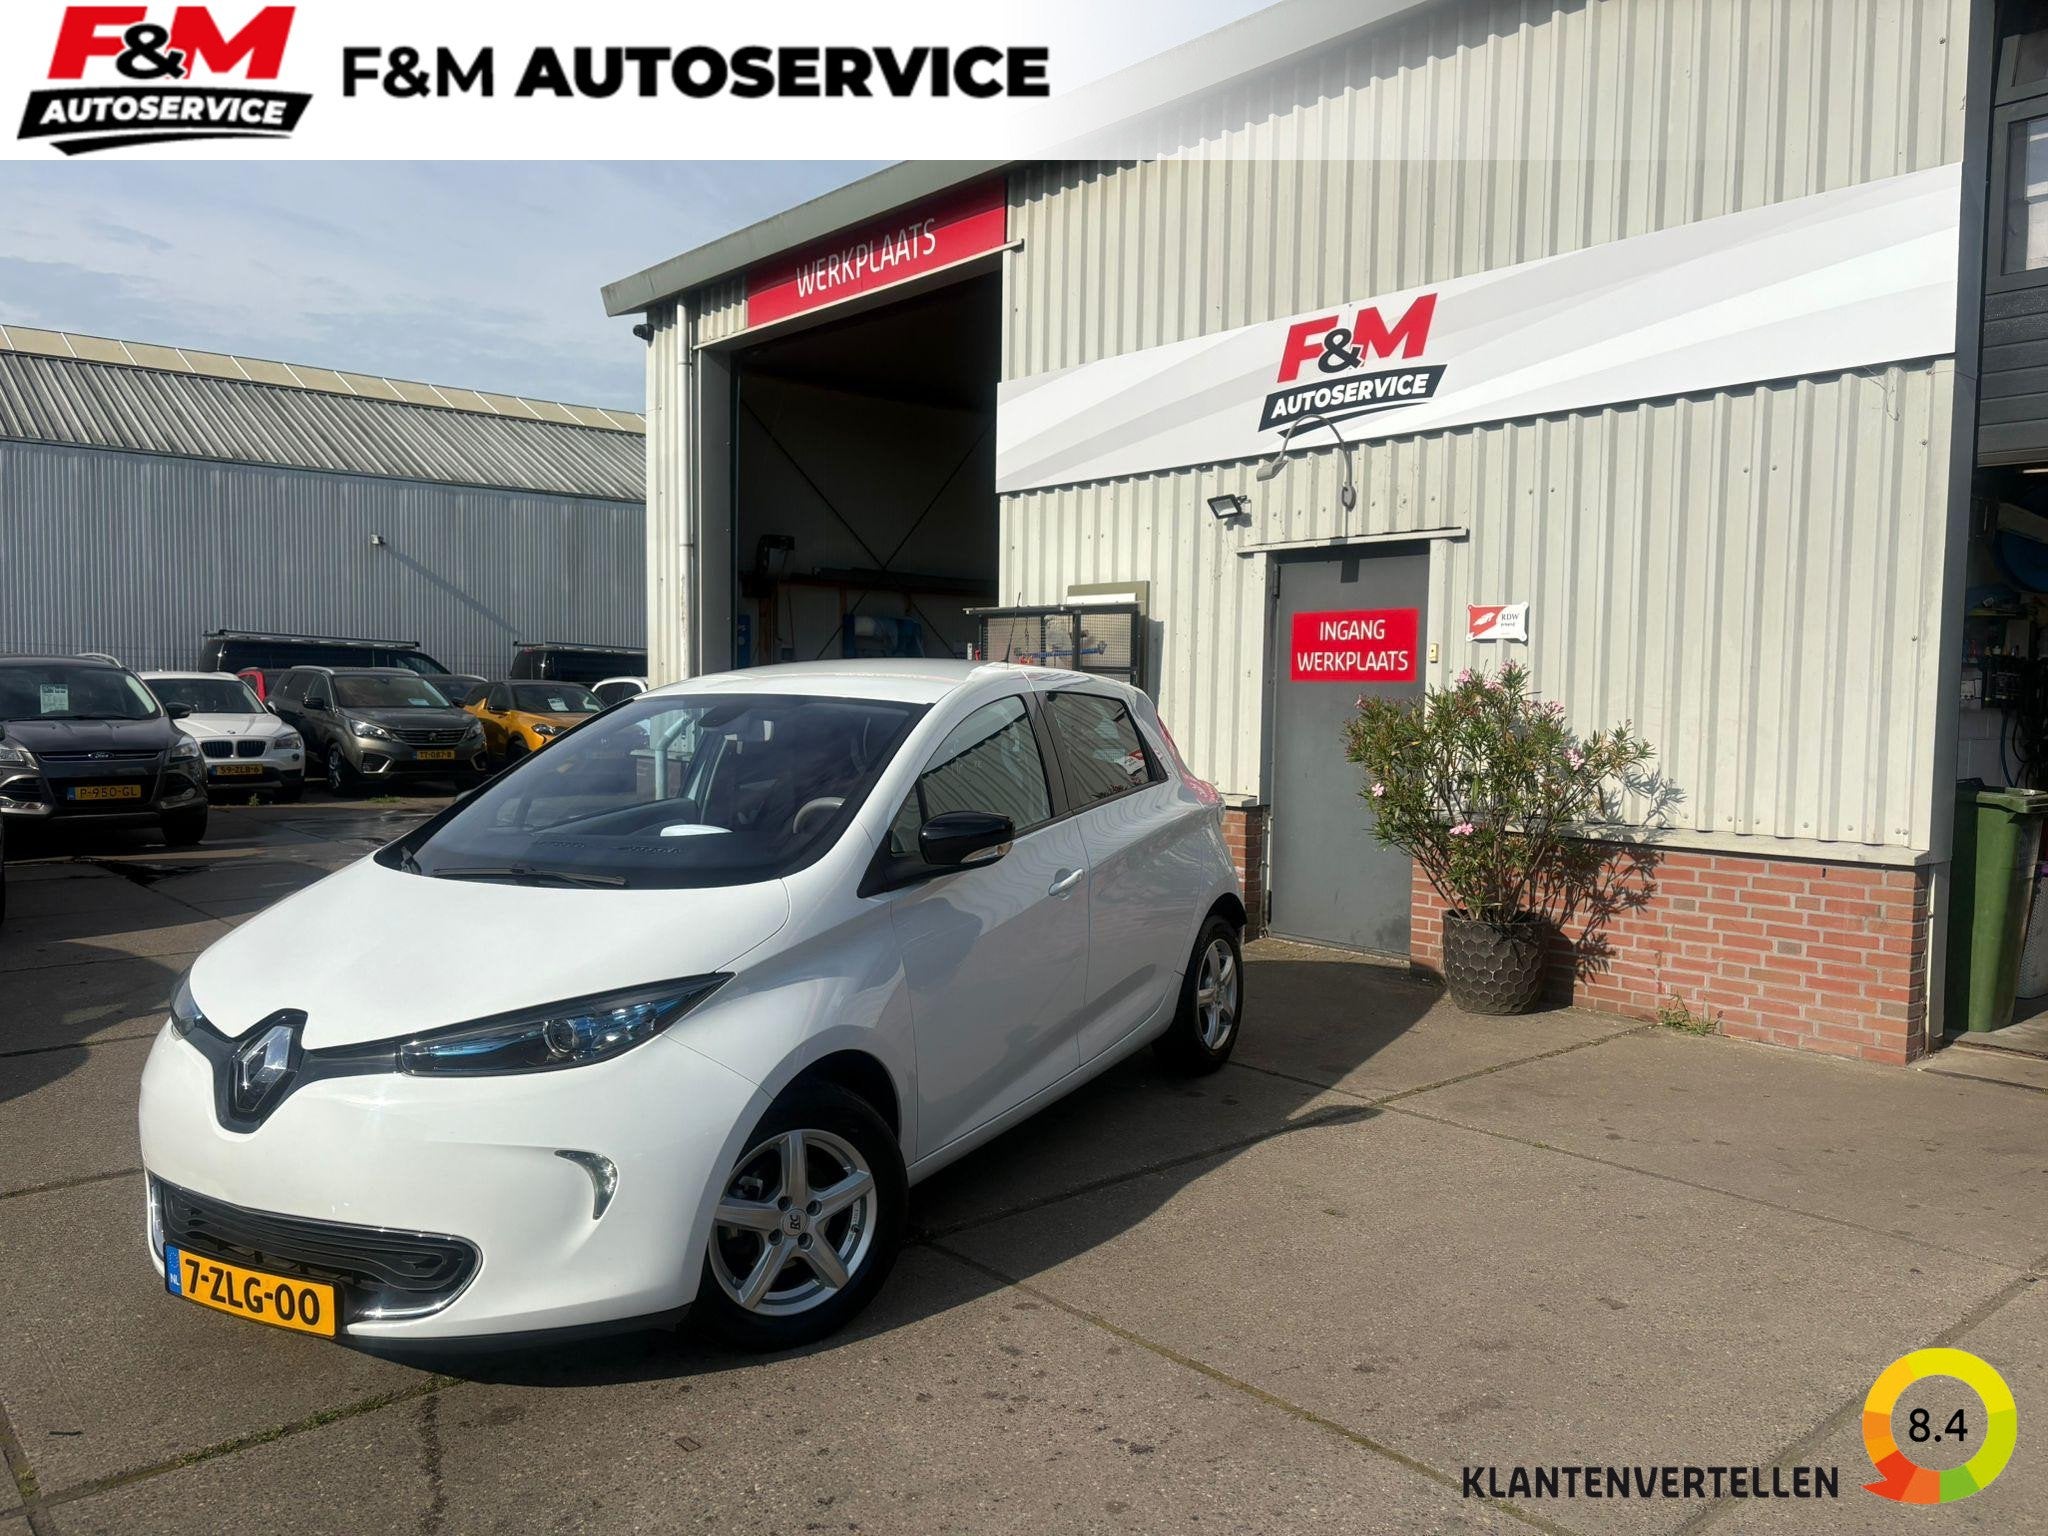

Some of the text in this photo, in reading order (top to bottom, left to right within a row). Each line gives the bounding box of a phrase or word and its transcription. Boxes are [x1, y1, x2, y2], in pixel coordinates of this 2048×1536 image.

[796, 217, 936, 298] WERKPLAATS
[1276, 292, 1438, 383] F&M
[1270, 373, 1429, 419] AUTOSERVICE
[1319, 619, 1386, 641] INGANG
[1297, 650, 1409, 672] WERKPLAATS
[80, 786, 137, 798] P-950-GL
[185, 1258, 320, 1326] 7-ZLG-00
